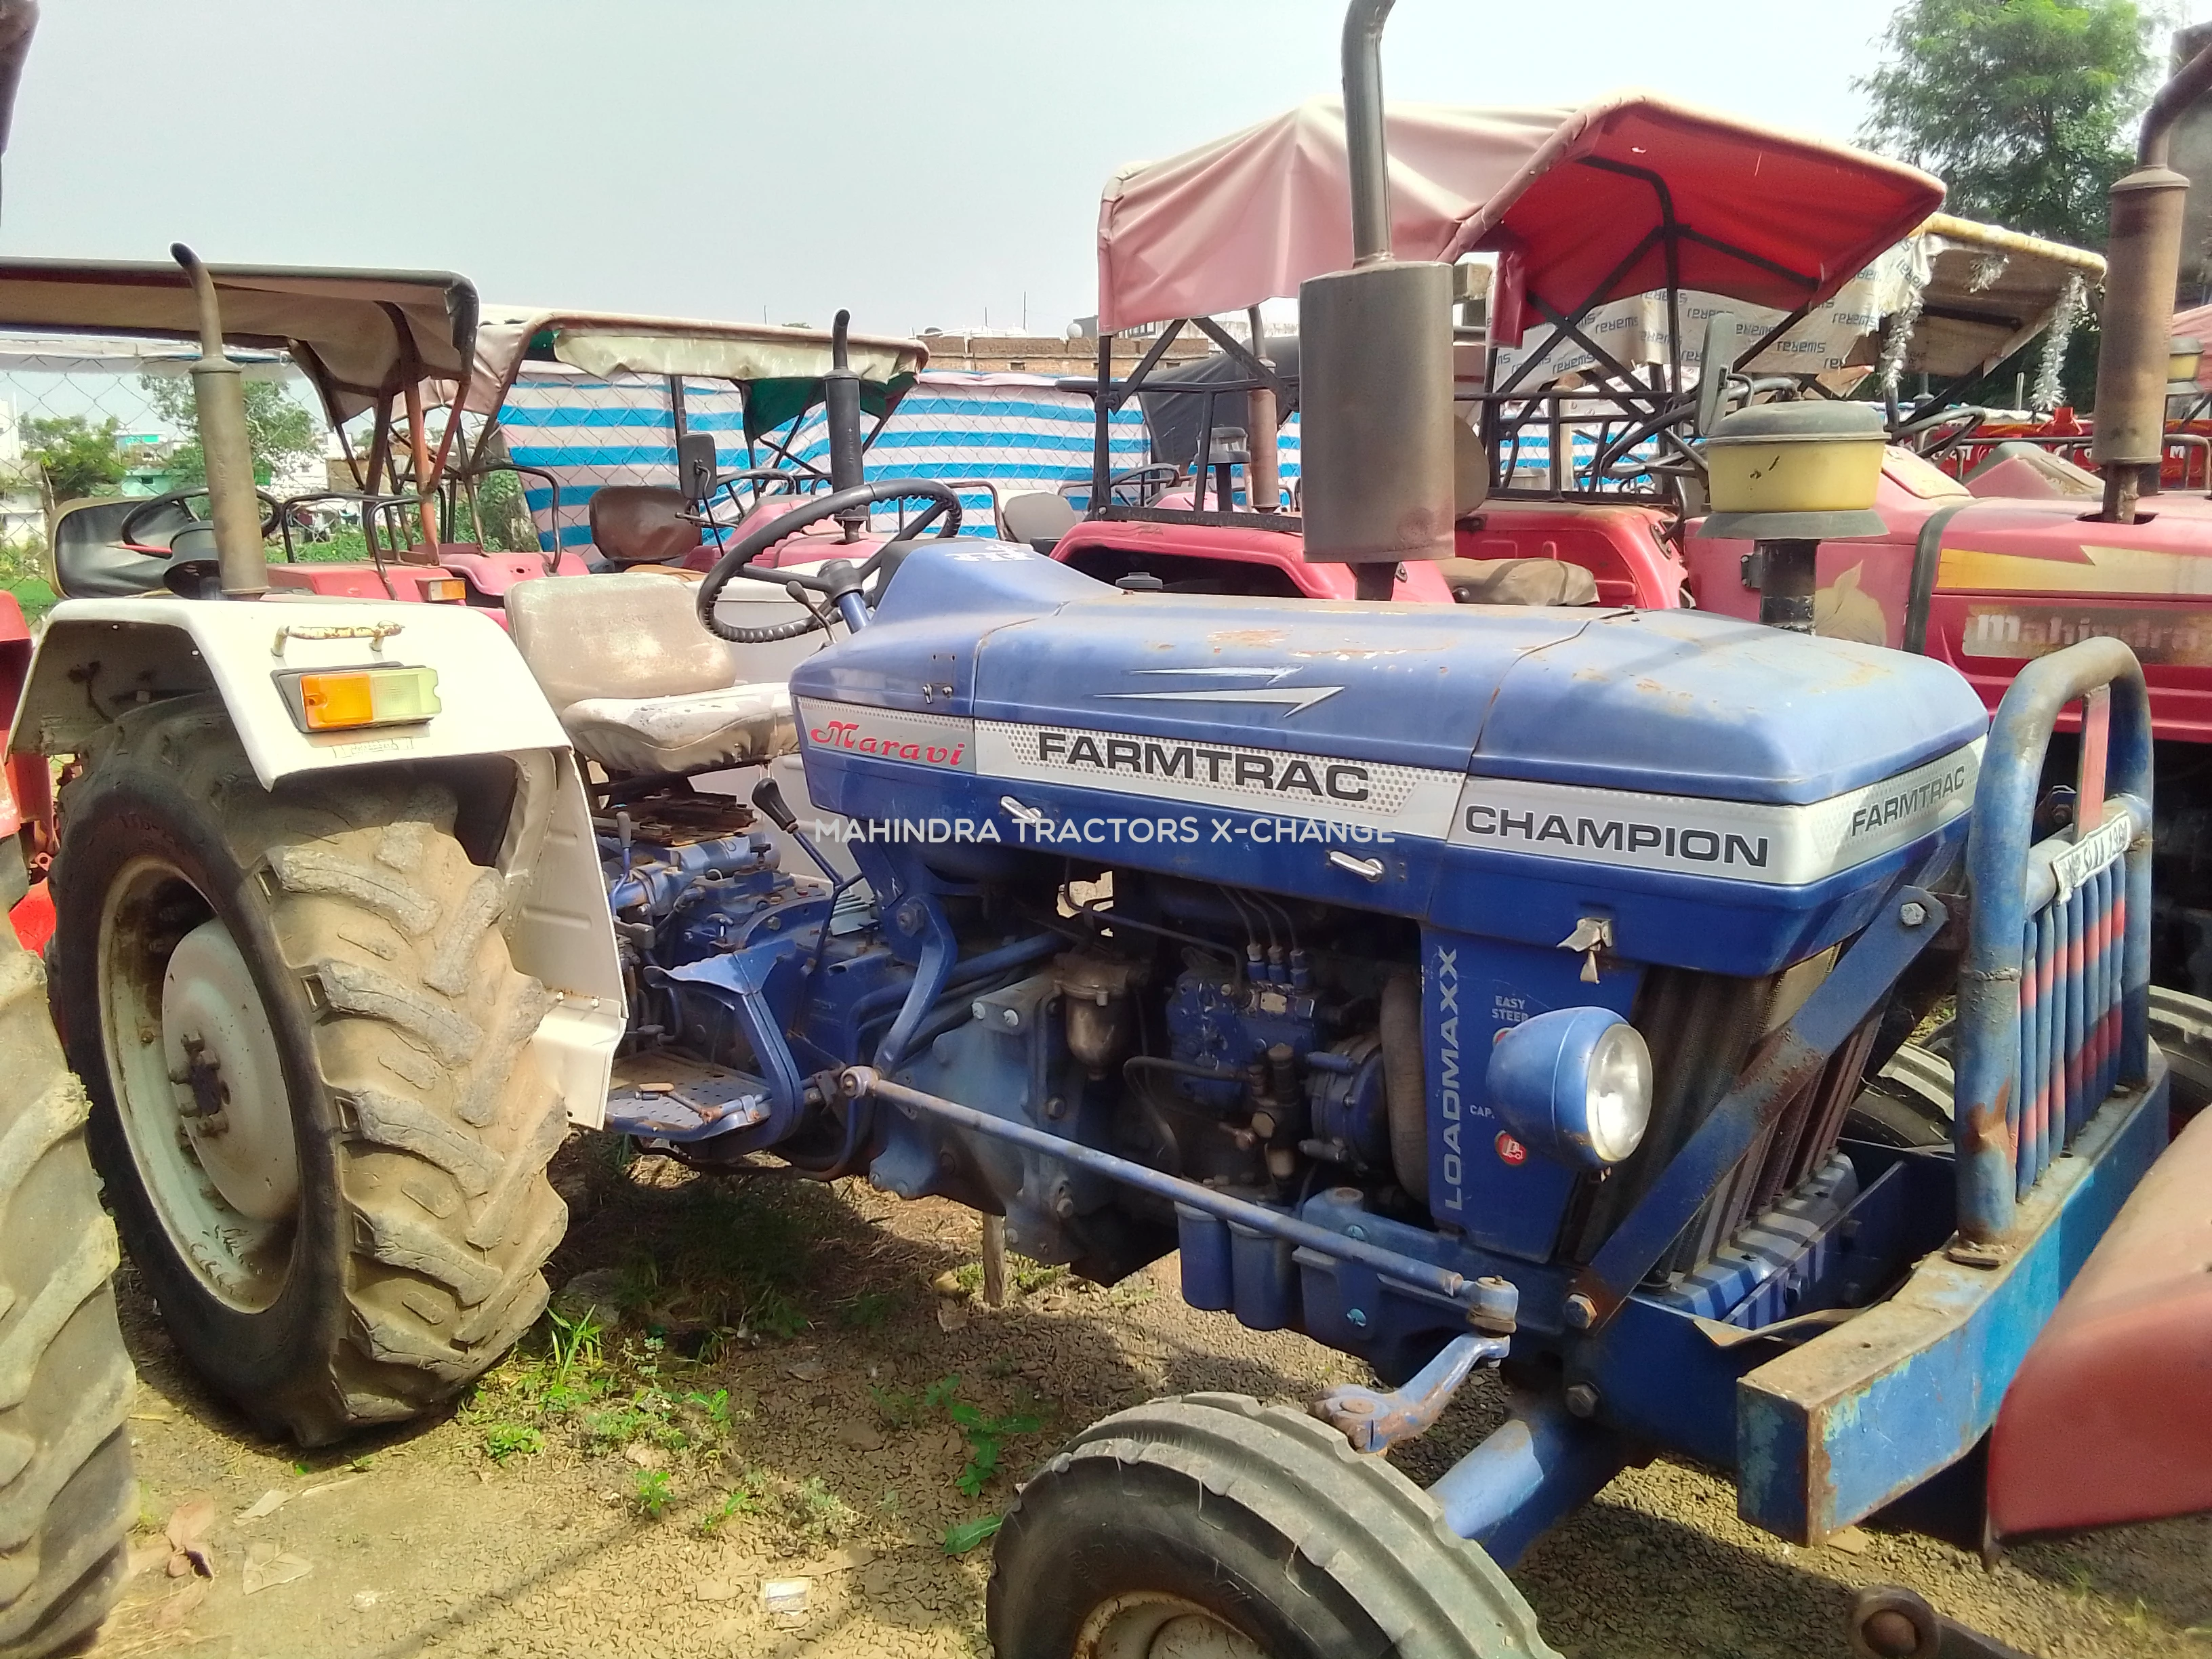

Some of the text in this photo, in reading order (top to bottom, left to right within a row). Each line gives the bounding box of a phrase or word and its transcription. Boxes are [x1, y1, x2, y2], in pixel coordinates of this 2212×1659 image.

[811, 720, 965, 766] Maravi
[1038, 731, 1369, 802] FARMTRAC
[1851, 764, 1965, 837] FARMTRAC
[1465, 804, 1768, 867] CHAMPION
[1495, 995, 1525, 1010] EASY
[1437, 947, 1462, 1211] LOADMAXX
